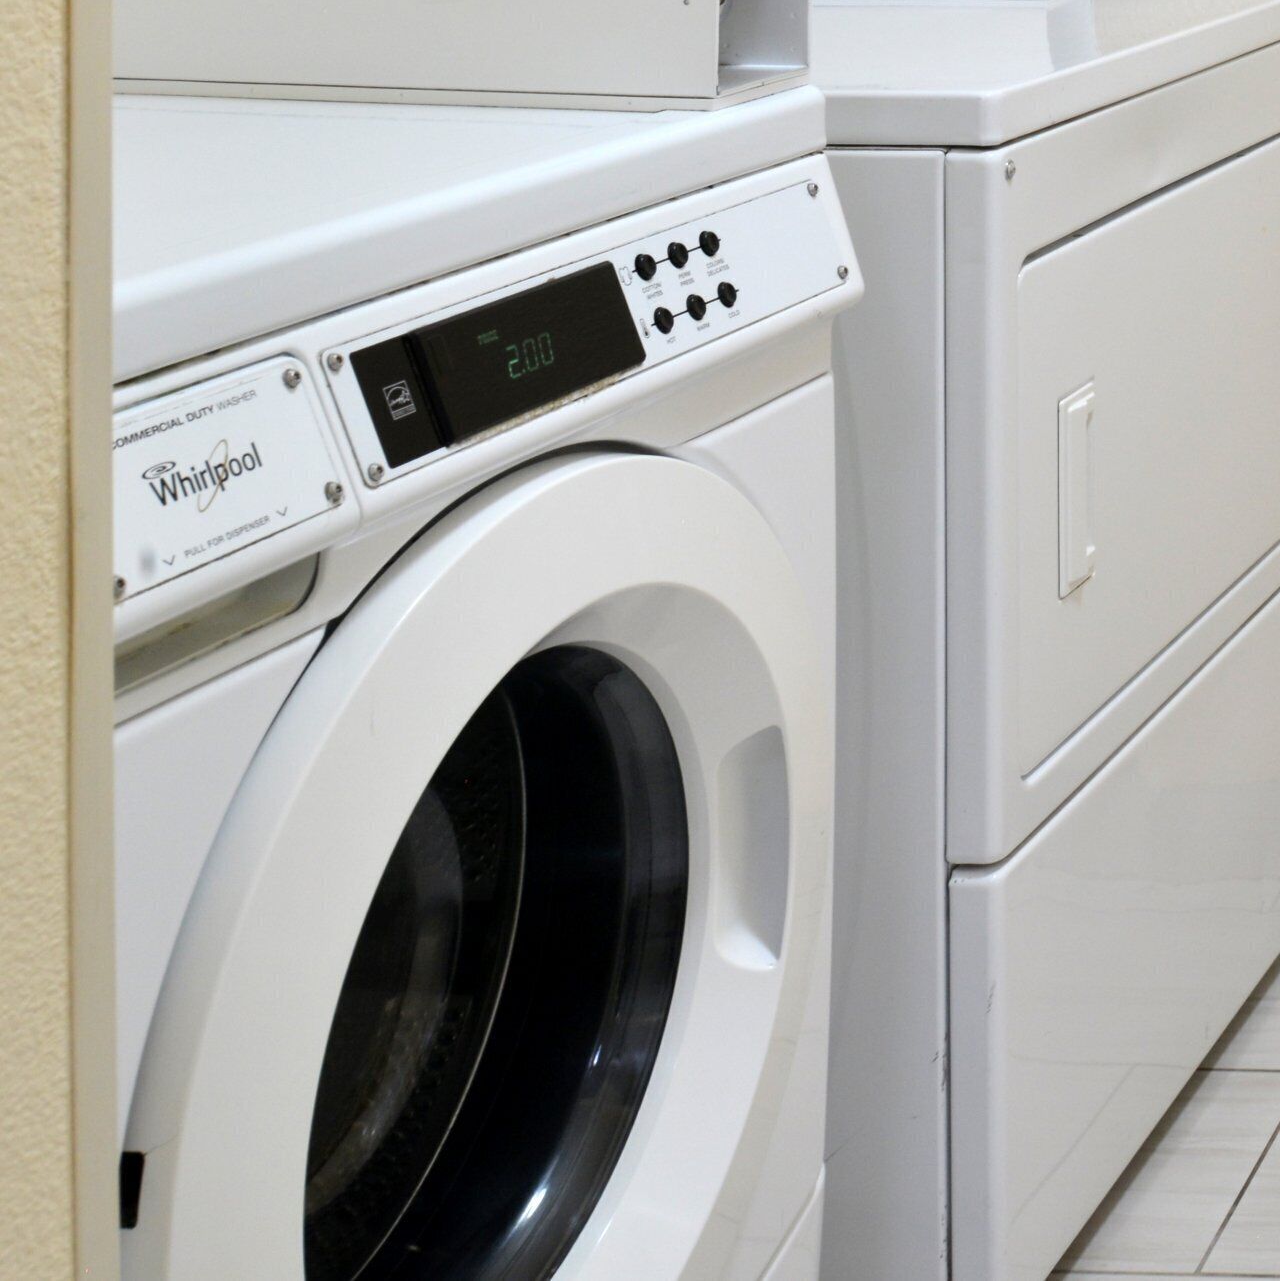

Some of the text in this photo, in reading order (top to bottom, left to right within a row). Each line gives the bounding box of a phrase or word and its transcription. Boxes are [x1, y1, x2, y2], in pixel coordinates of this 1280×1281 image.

[506, 332, 554, 379] 2.00
[185, 404, 214, 422] DUTY
[216, 389, 257, 411] WASHER
[149, 442, 262, 506] Whirlpool
[184, 515, 270, 557] PULL FOR DISPENSER
